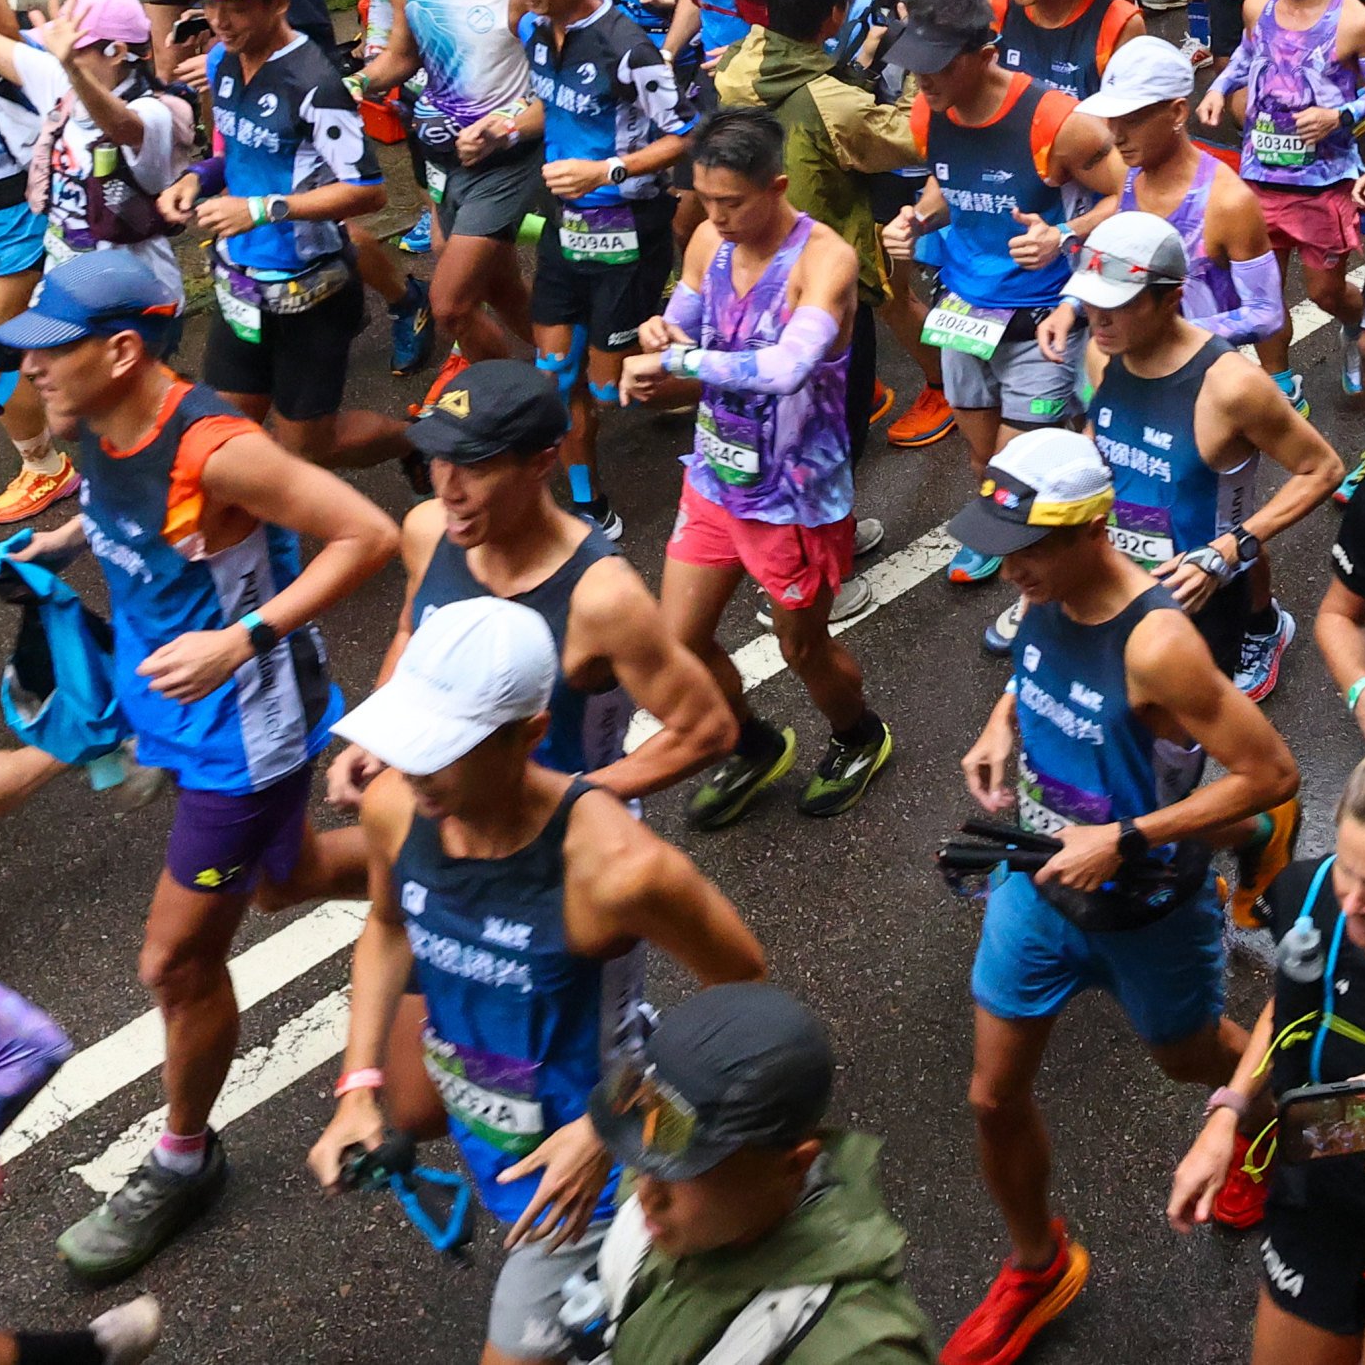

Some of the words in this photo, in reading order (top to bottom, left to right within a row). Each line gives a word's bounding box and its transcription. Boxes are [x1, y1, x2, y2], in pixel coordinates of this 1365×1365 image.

[1256, 133, 1304, 153] 8034D
[933, 313, 990, 339] 8082A
[1109, 527, 1158, 559] 092C
